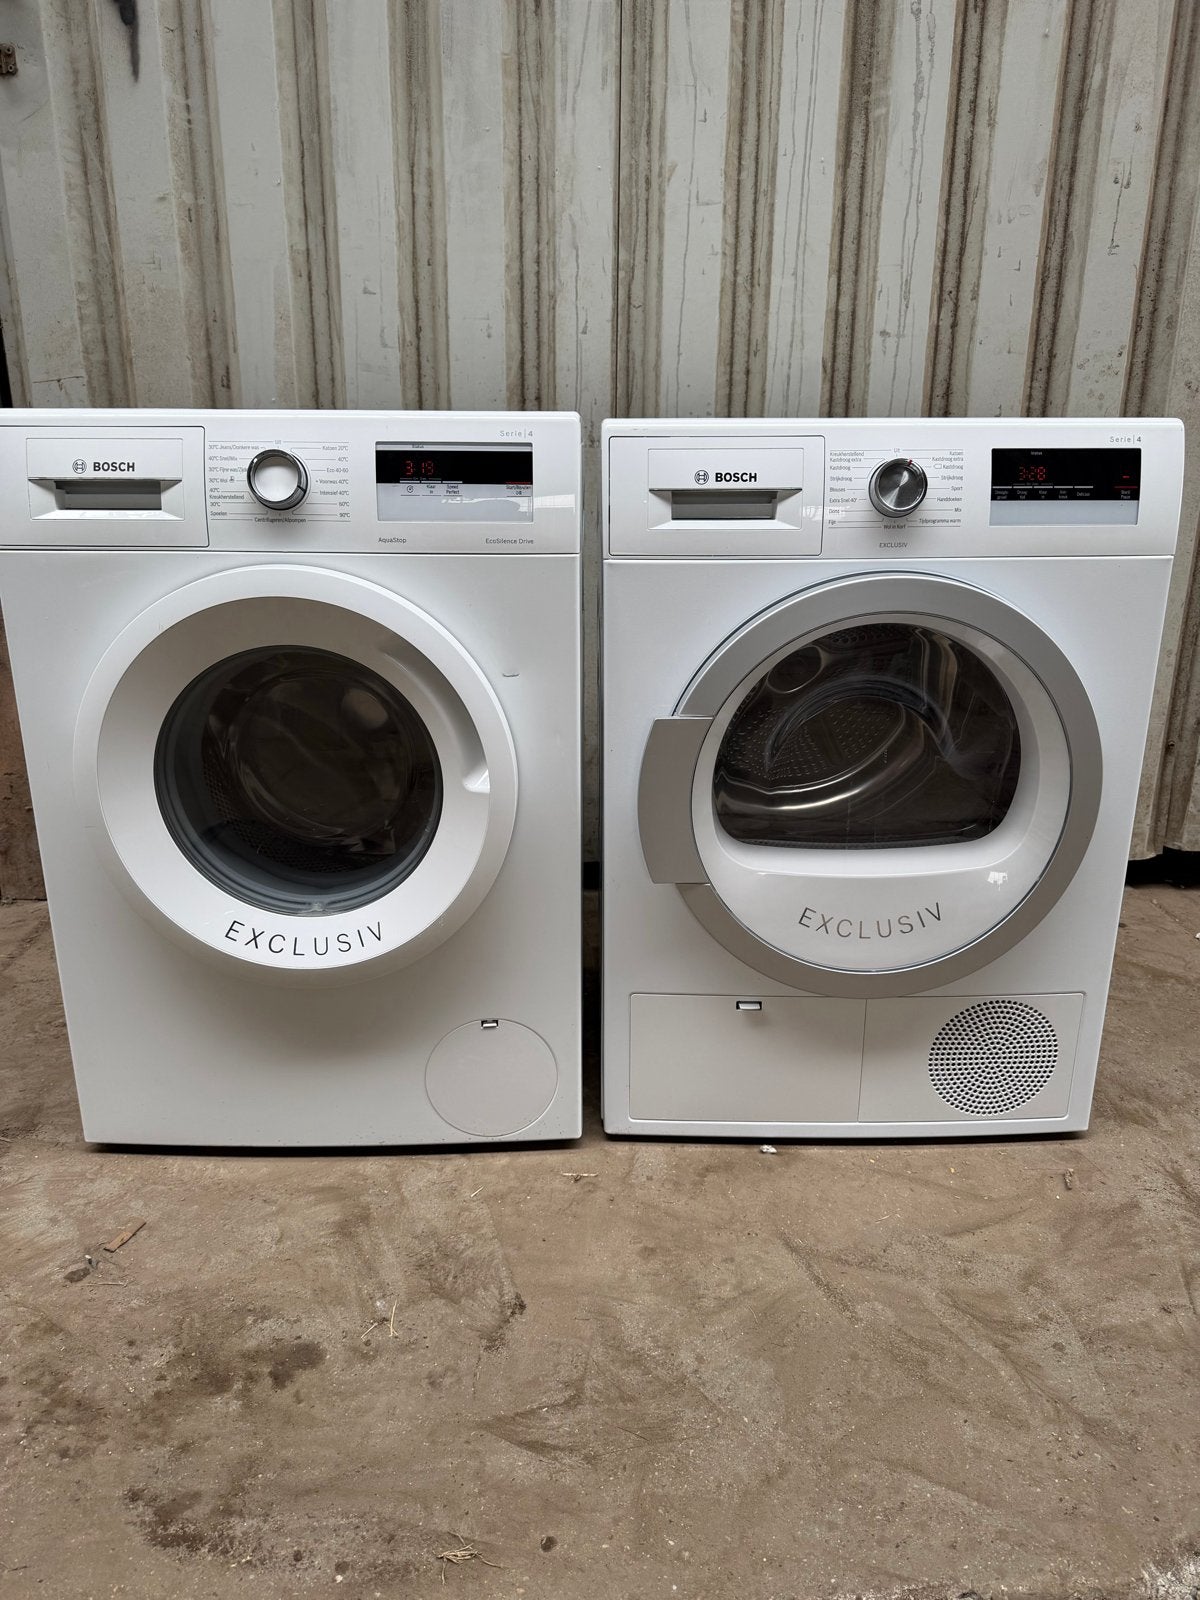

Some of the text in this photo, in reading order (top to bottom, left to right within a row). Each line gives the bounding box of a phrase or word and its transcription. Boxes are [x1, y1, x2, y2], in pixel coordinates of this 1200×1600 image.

[93, 462, 135, 472] BOSCH
[714, 472, 757, 482] BOSCH
[798, 902, 942, 939] EXCLUSIV
[225, 920, 382, 956] EXCLUSIV
